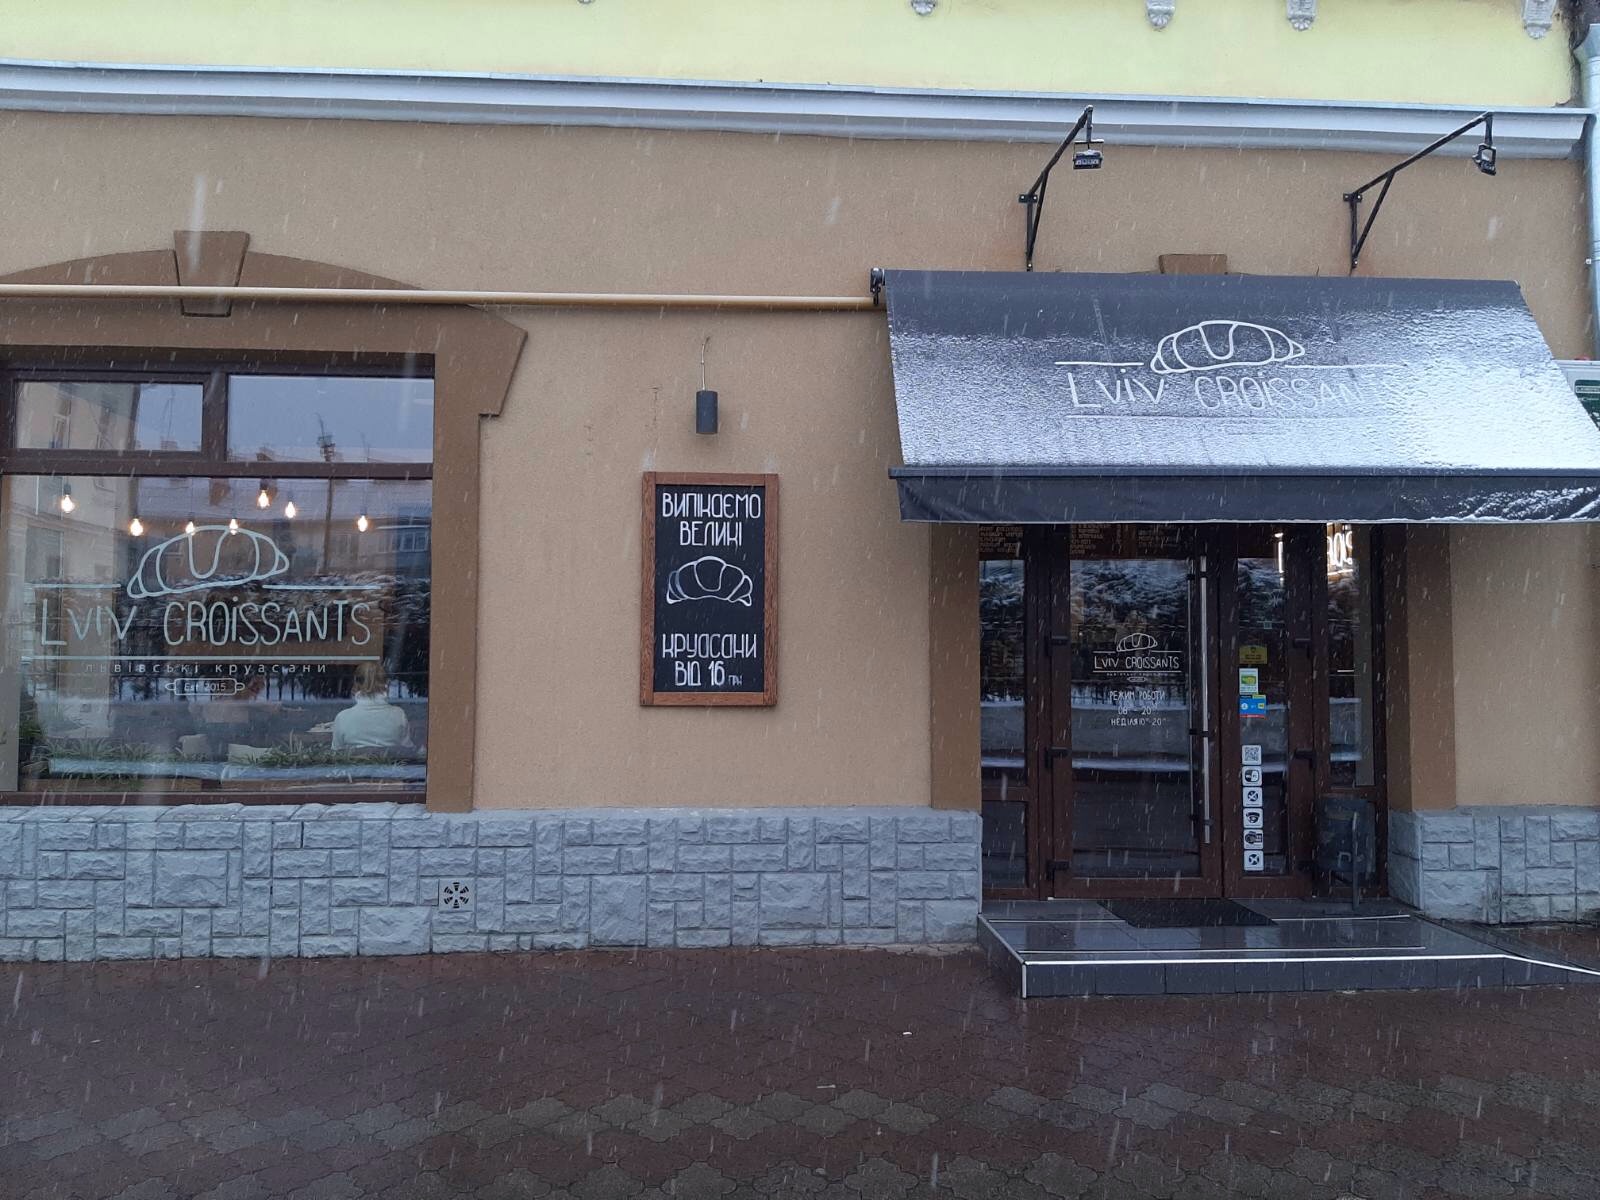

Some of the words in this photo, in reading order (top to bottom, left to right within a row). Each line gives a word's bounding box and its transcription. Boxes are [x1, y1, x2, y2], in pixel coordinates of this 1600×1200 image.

[662, 492, 761, 519] ВИПІКАЄМО
[679, 521, 743, 546] ВЕЛИКІ
[662, 633, 758, 659] КРУАСАНИ
[215, 663, 327, 675] круасани
[674, 661, 702, 687] ВІД
[708, 660, 725, 687] 16
[204, 682, 227, 691] 2015
